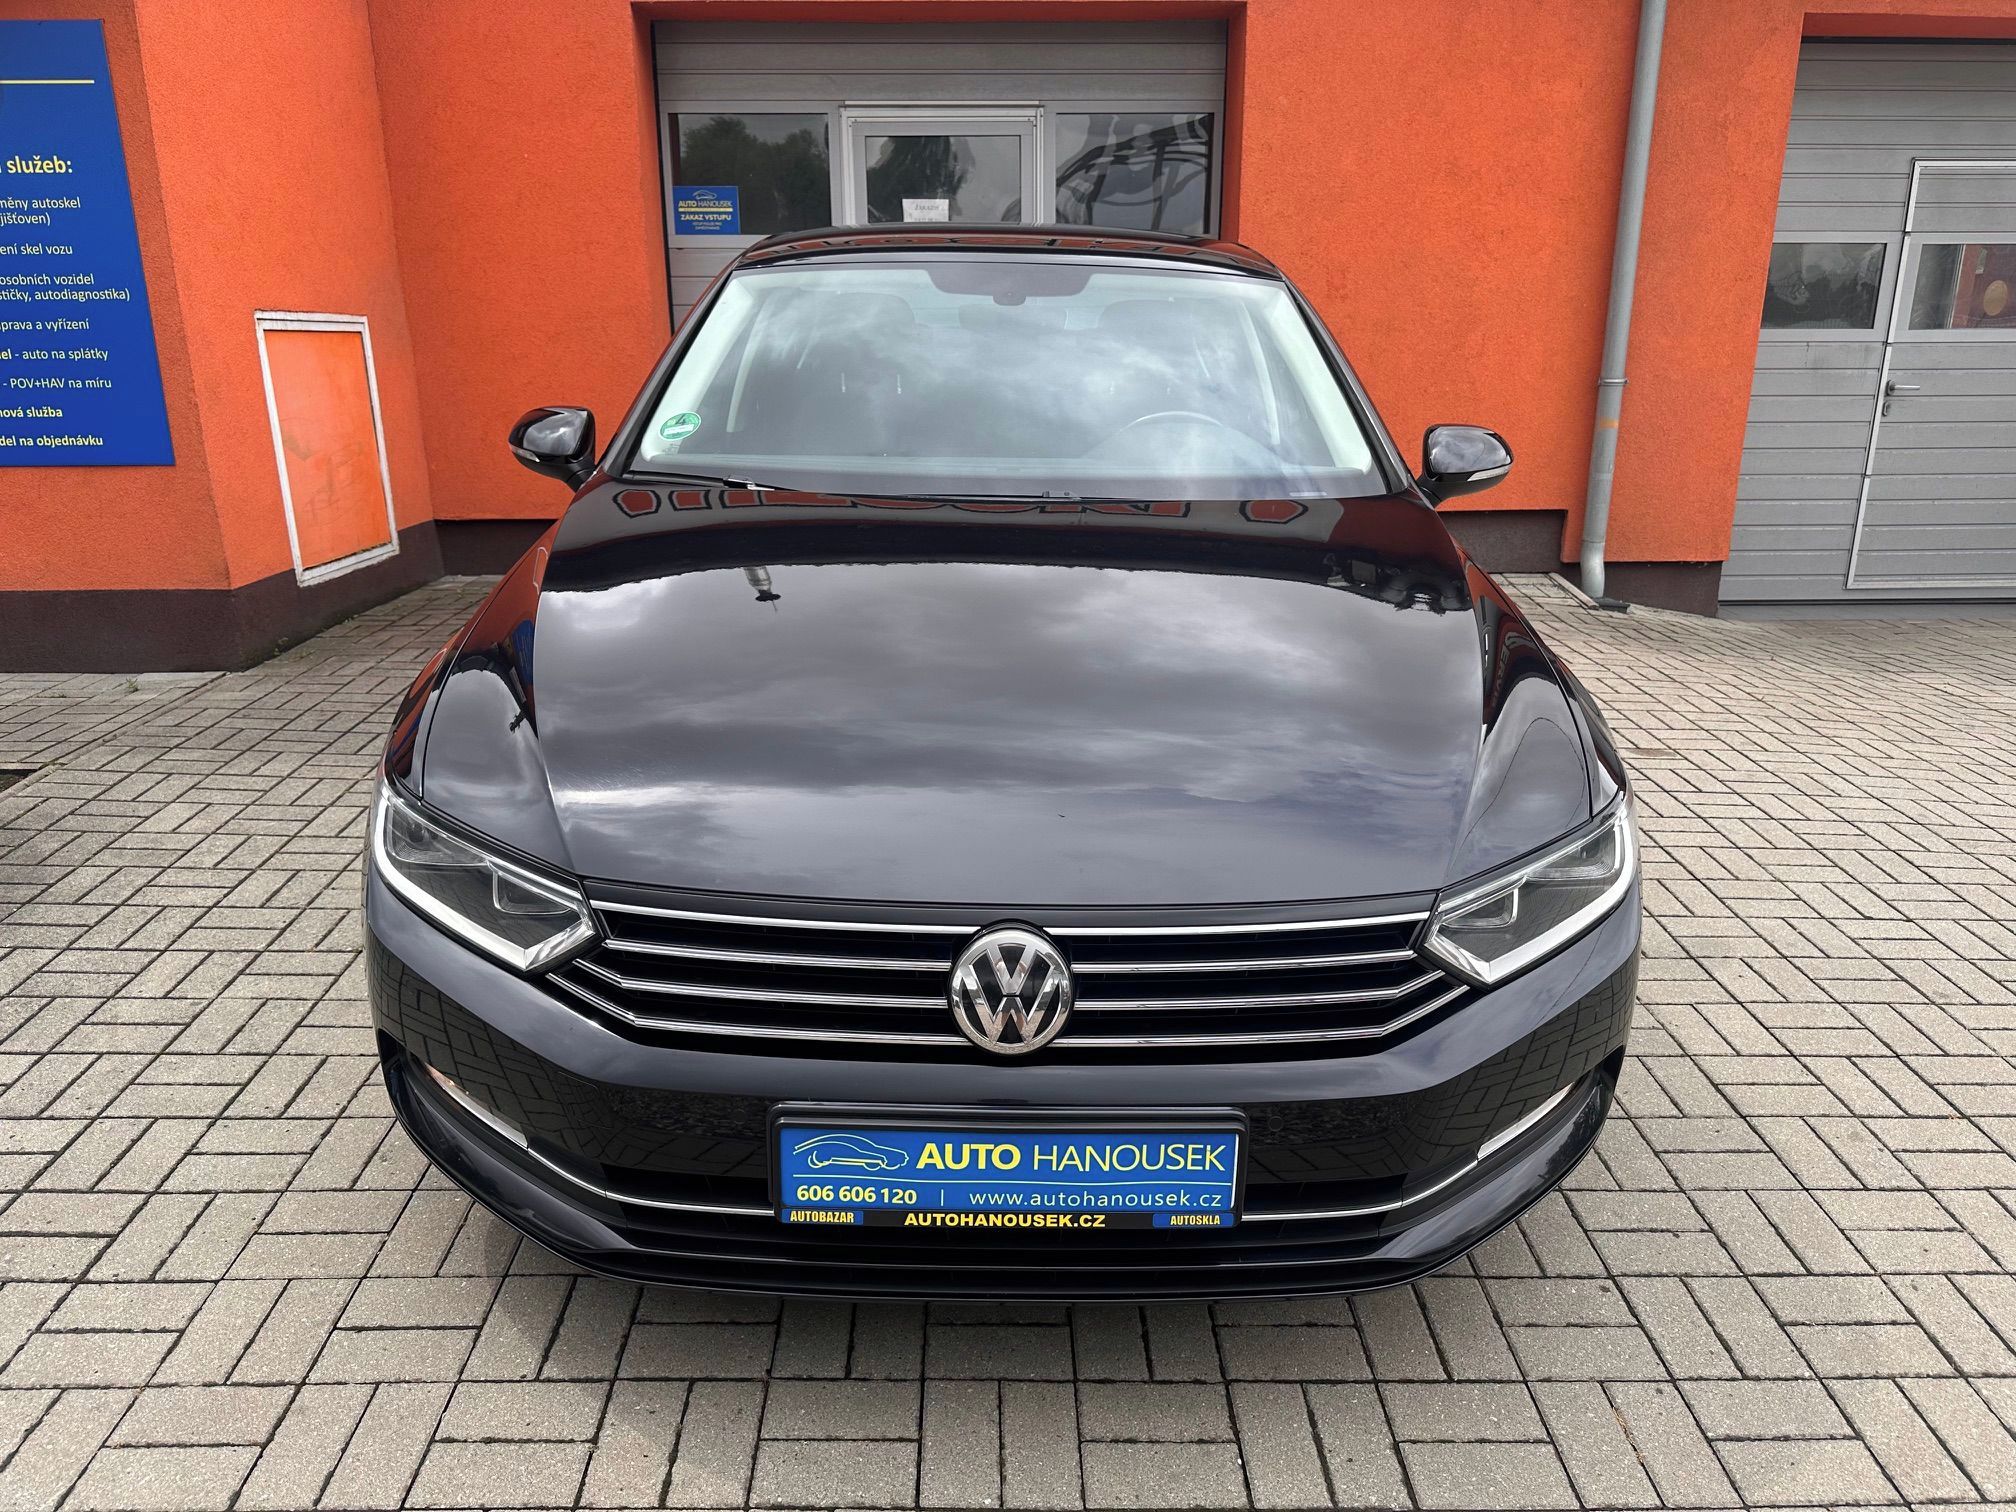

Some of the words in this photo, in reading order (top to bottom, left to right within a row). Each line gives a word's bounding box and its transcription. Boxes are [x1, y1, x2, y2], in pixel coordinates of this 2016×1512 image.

[6, 155, 73, 174] služeb:
[32, 196, 81, 209] autoskel
[678, 200, 697, 208] AUTO
[21, 243, 43, 255] skel
[45, 245, 73, 255] vozu
[0, 273, 51, 285] osobních
[53, 273, 95, 285] vozidel
[34, 287, 130, 302] autodiagnostika)
[36, 321, 43, 330] a
[45, 318, 90, 332] vyřízení
[22, 349, 49, 360] auto
[51, 350, 66, 360] na
[68, 347, 109, 362] splátky
[10, 377, 65, 389] POV+HAV
[68, 379, 83, 389] na
[85, 376, 112, 389] míru
[26, 406, 63, 418] služba
[19, 436, 34, 446] na
[36, 434, 104, 448] objednávku
[915, 1142, 1022, 1171] AUTO
[1033, 1143, 1227, 1173] HANOUSEK
[796, 1184, 835, 1202] 606
[838, 1185, 877, 1203] 606
[880, 1187, 918, 1205] 120
[968, 1189, 1222, 1207] www.autohanousek.cz
[789, 1210, 855, 1224] AUTOBAZAR
[903, 1212, 1106, 1228] AUTOHANOUSEK.CZ
[1169, 1214, 1221, 1226] AUTOSKLA
